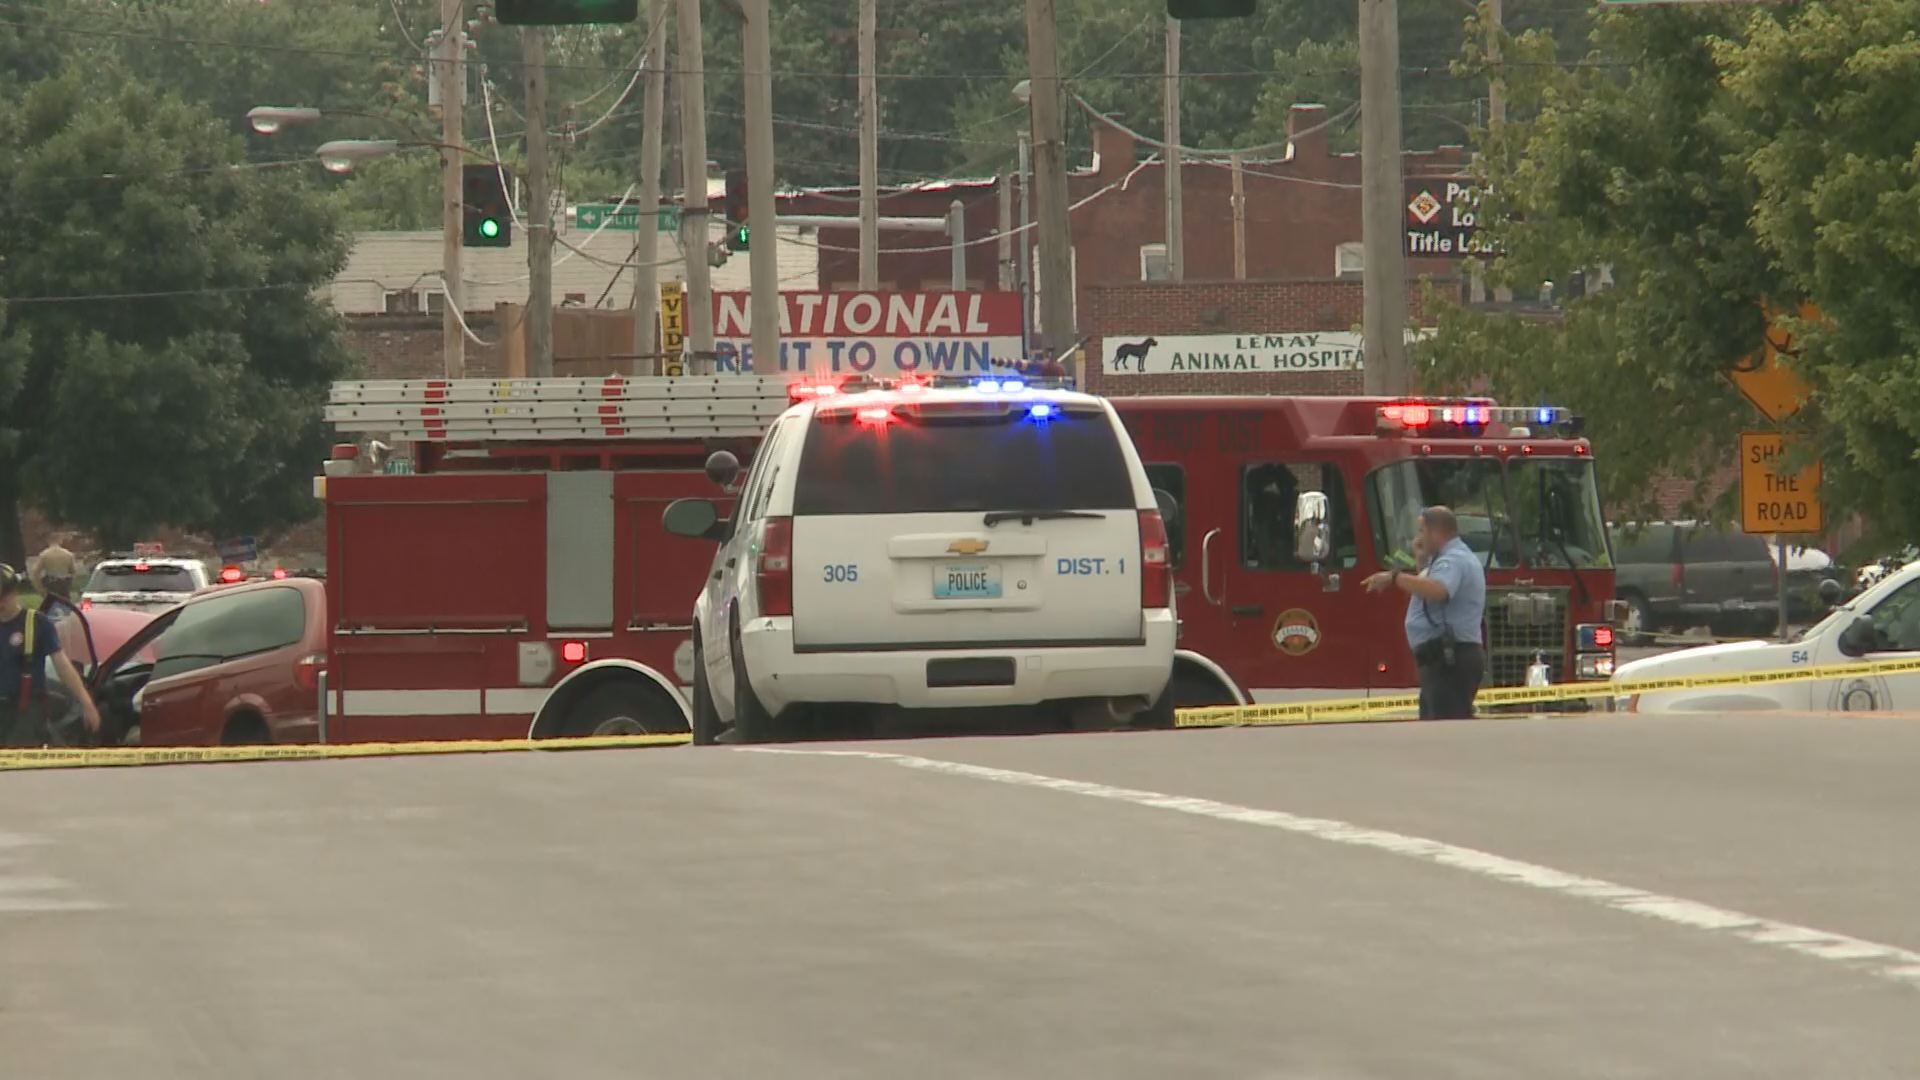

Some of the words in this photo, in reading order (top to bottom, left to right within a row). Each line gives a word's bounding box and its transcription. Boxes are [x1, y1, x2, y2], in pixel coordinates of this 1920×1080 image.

[1408, 231, 1452, 252] Title
[1236, 335, 1320, 350] LEMAY
[827, 341, 877, 373] TO
[894, 341, 990, 373] OWN
[1170, 352, 1260, 371] ANIMAL
[1273, 349, 1365, 370] HOSPITA
[1764, 474, 1800, 493] THE
[1757, 502, 1808, 521] ROAD
[823, 564, 859, 582] 305
[1057, 558, 1110, 575] DIST.
[1118, 558, 1126, 574] 1
[948, 572, 987, 591] POLICE
[1791, 650, 1808, 663] 54
